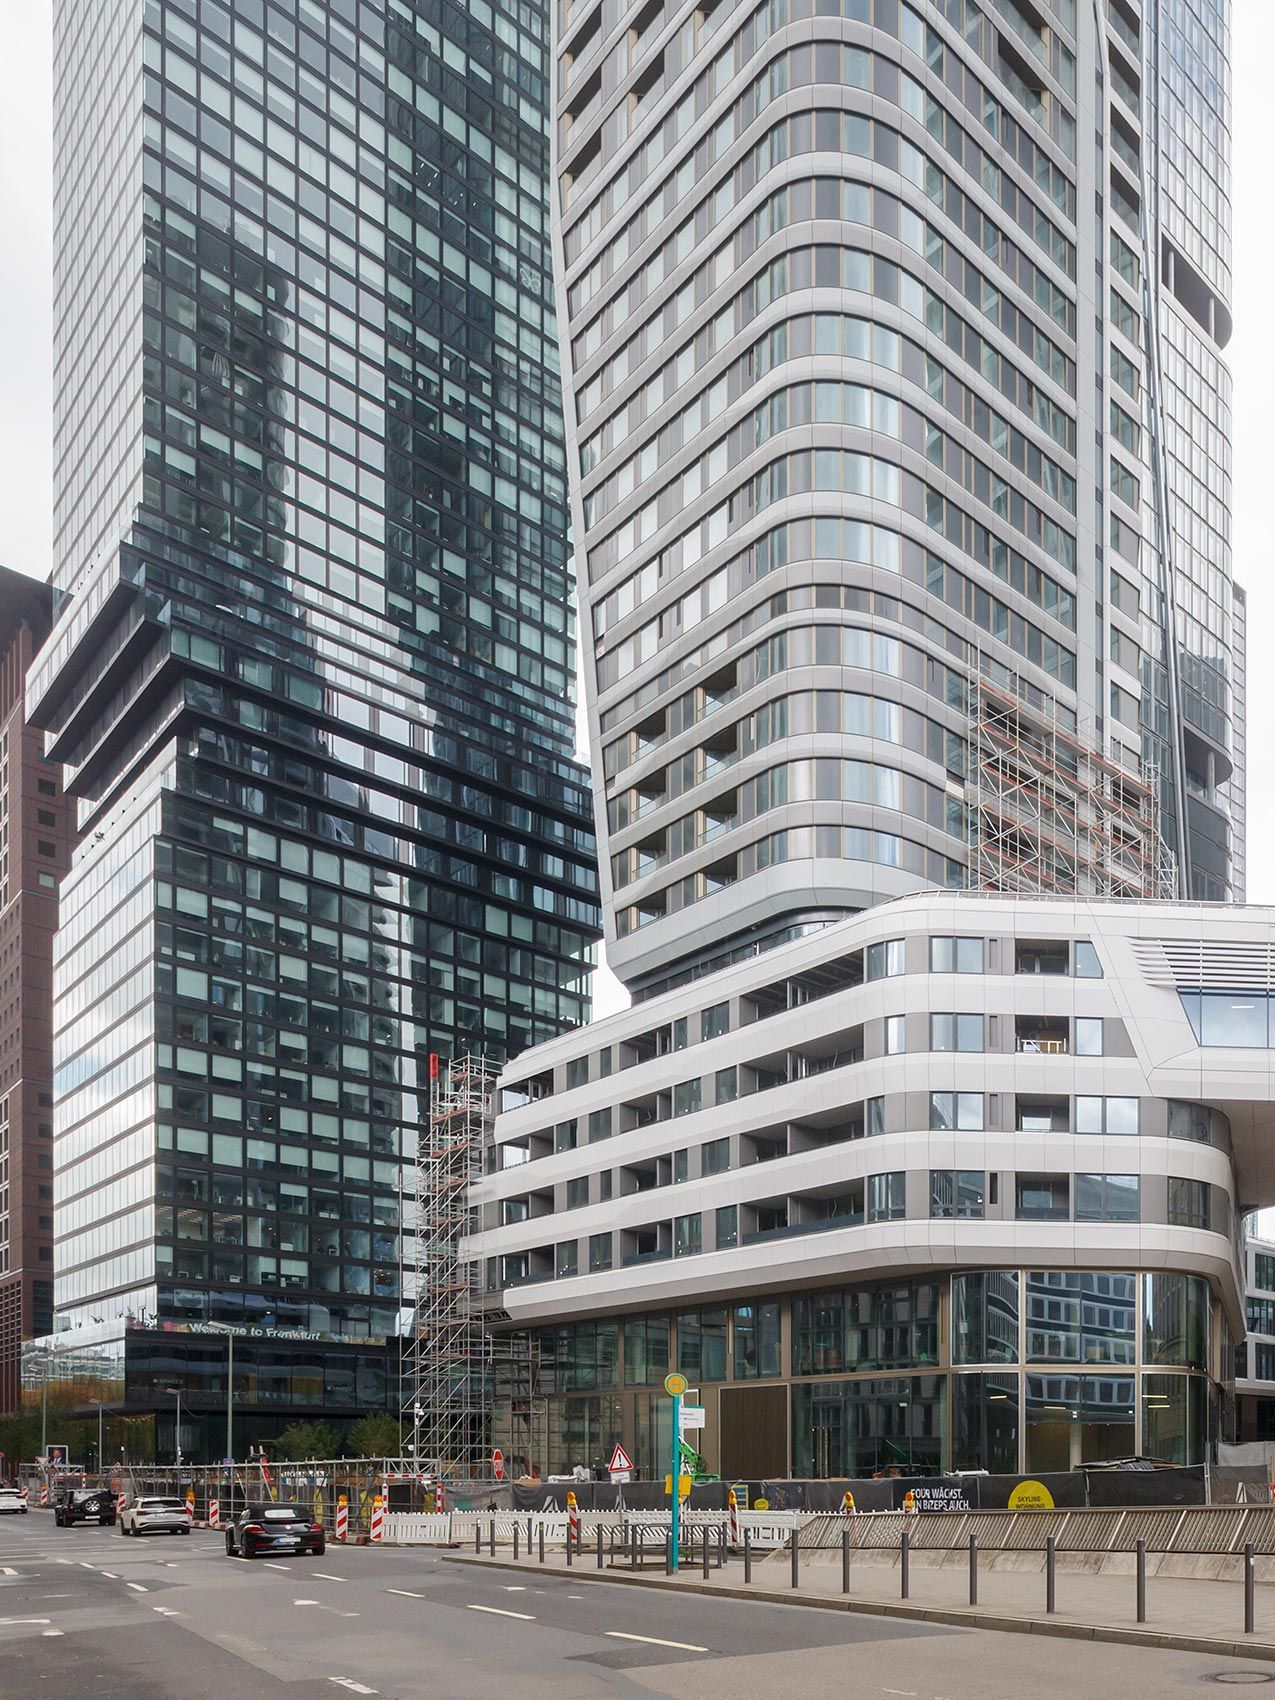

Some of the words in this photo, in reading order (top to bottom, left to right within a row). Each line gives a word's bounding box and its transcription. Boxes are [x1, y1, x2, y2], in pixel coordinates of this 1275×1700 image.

[251, 1327, 263, 1336] to
[266, 1328, 320, 1340] Frankfurt
[911, 1489, 930, 1498] FOUR
[931, 1486, 963, 1499] WÄCHST.
[923, 1500, 947, 1510] BIZEPS
[949, 1500, 972, 1511] AUCH.
